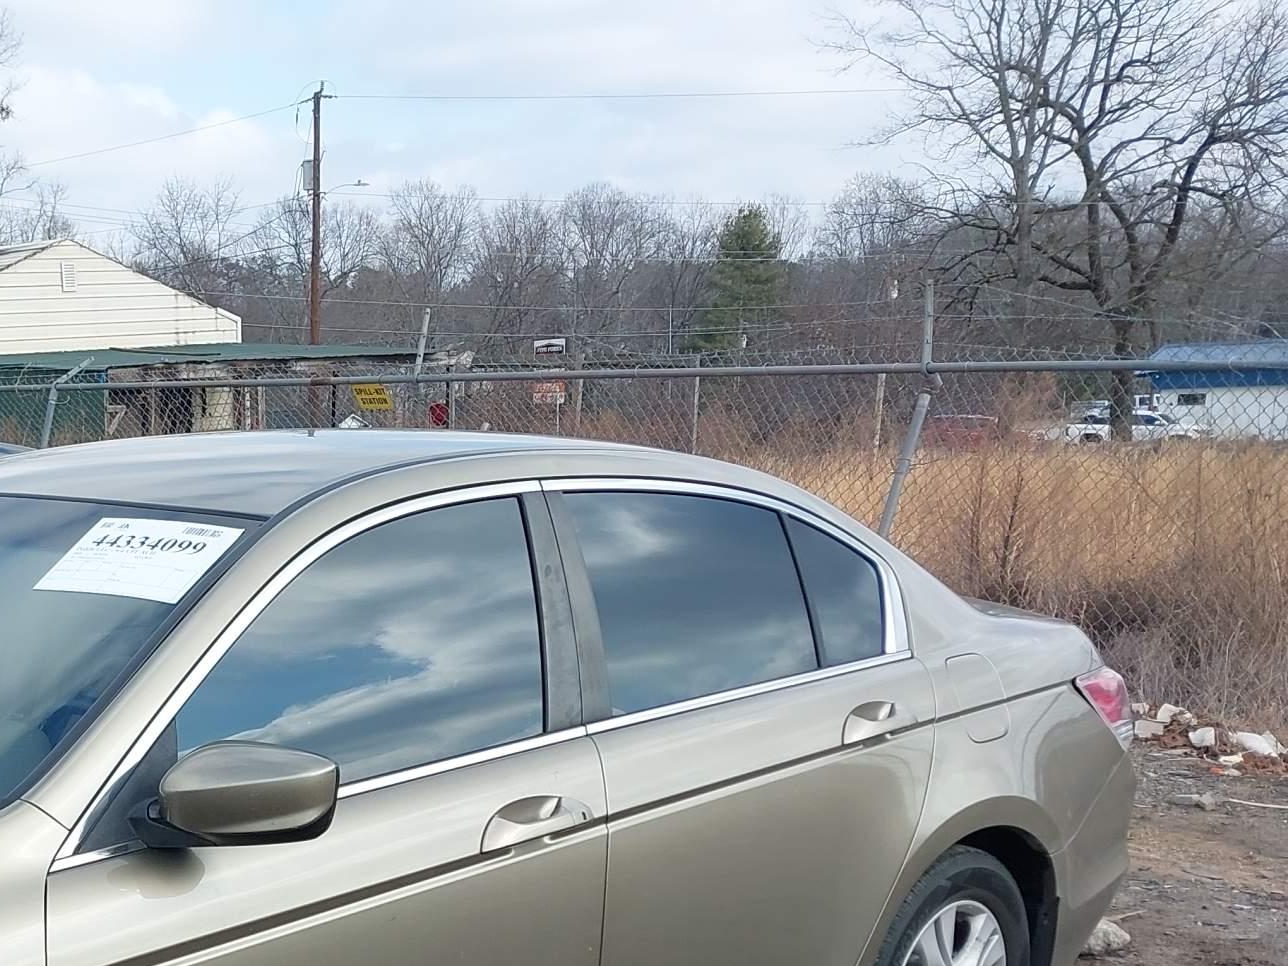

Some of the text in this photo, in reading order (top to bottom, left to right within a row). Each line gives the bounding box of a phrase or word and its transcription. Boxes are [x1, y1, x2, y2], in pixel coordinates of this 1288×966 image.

[354, 388, 386, 396] SPILL-KIT
[360, 397, 389, 405] STATION
[92, 533, 207, 555] 44334099
